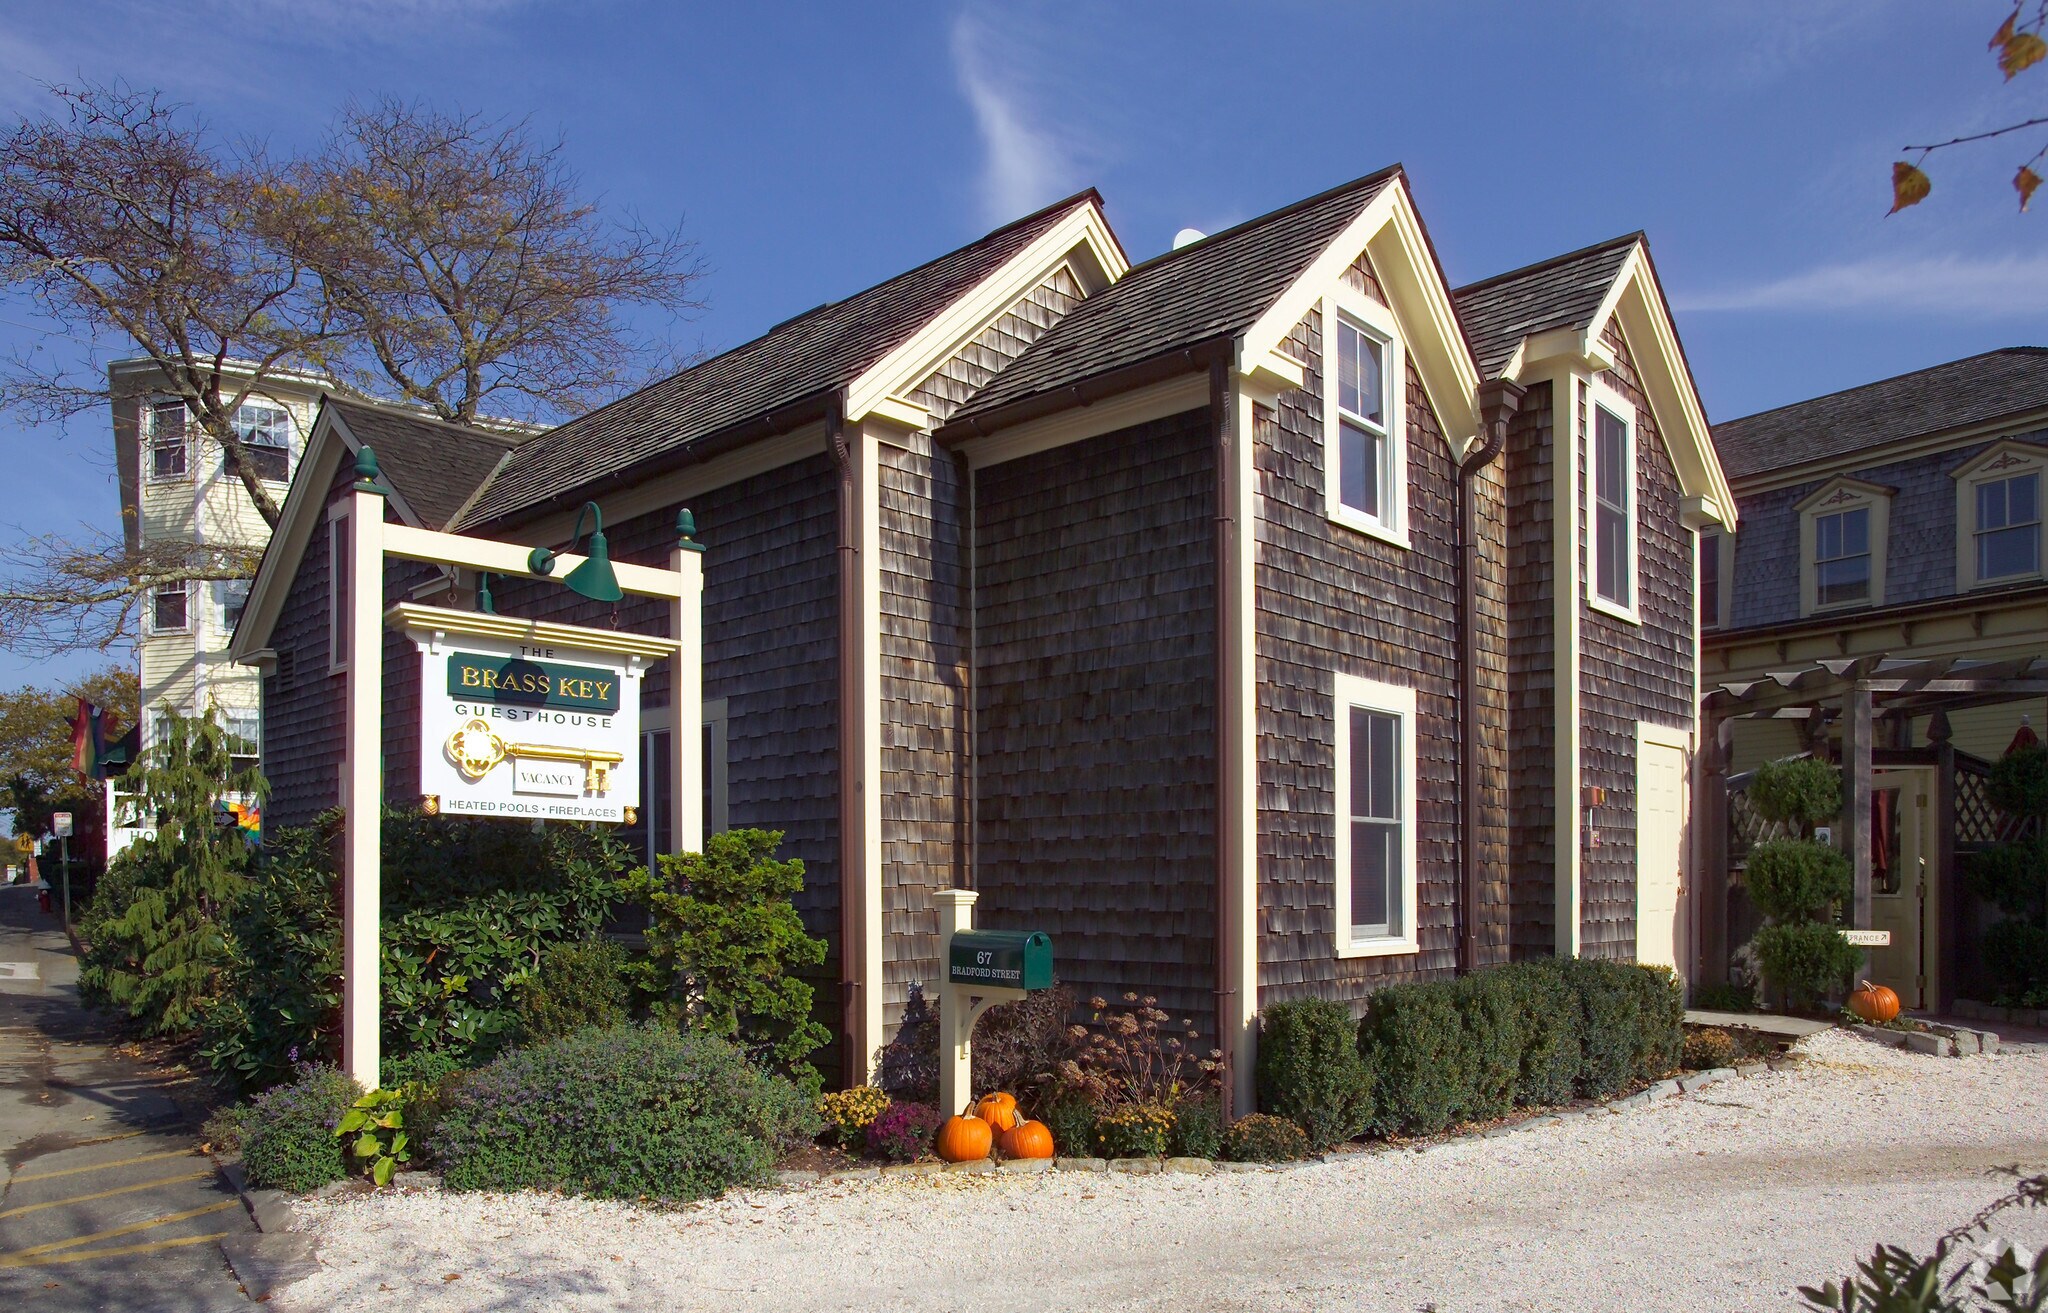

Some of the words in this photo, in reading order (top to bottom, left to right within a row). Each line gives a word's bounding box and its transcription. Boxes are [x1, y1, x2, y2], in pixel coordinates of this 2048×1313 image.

[519, 645, 554, 659] THE
[460, 665, 550, 694] BRASS
[558, 677, 612, 701] KEY
[455, 704, 612, 728] GUESTHOUSE
[521, 771, 576, 786] VACANCY
[449, 799, 496, 811] HEATED
[499, 802, 539, 814] POOLS
[549, 805, 617, 818] FIREPLACES
[977, 951, 992, 964] 67
[952, 965, 991, 977] BRADFORD
[991, 969, 1021, 979] STREET
